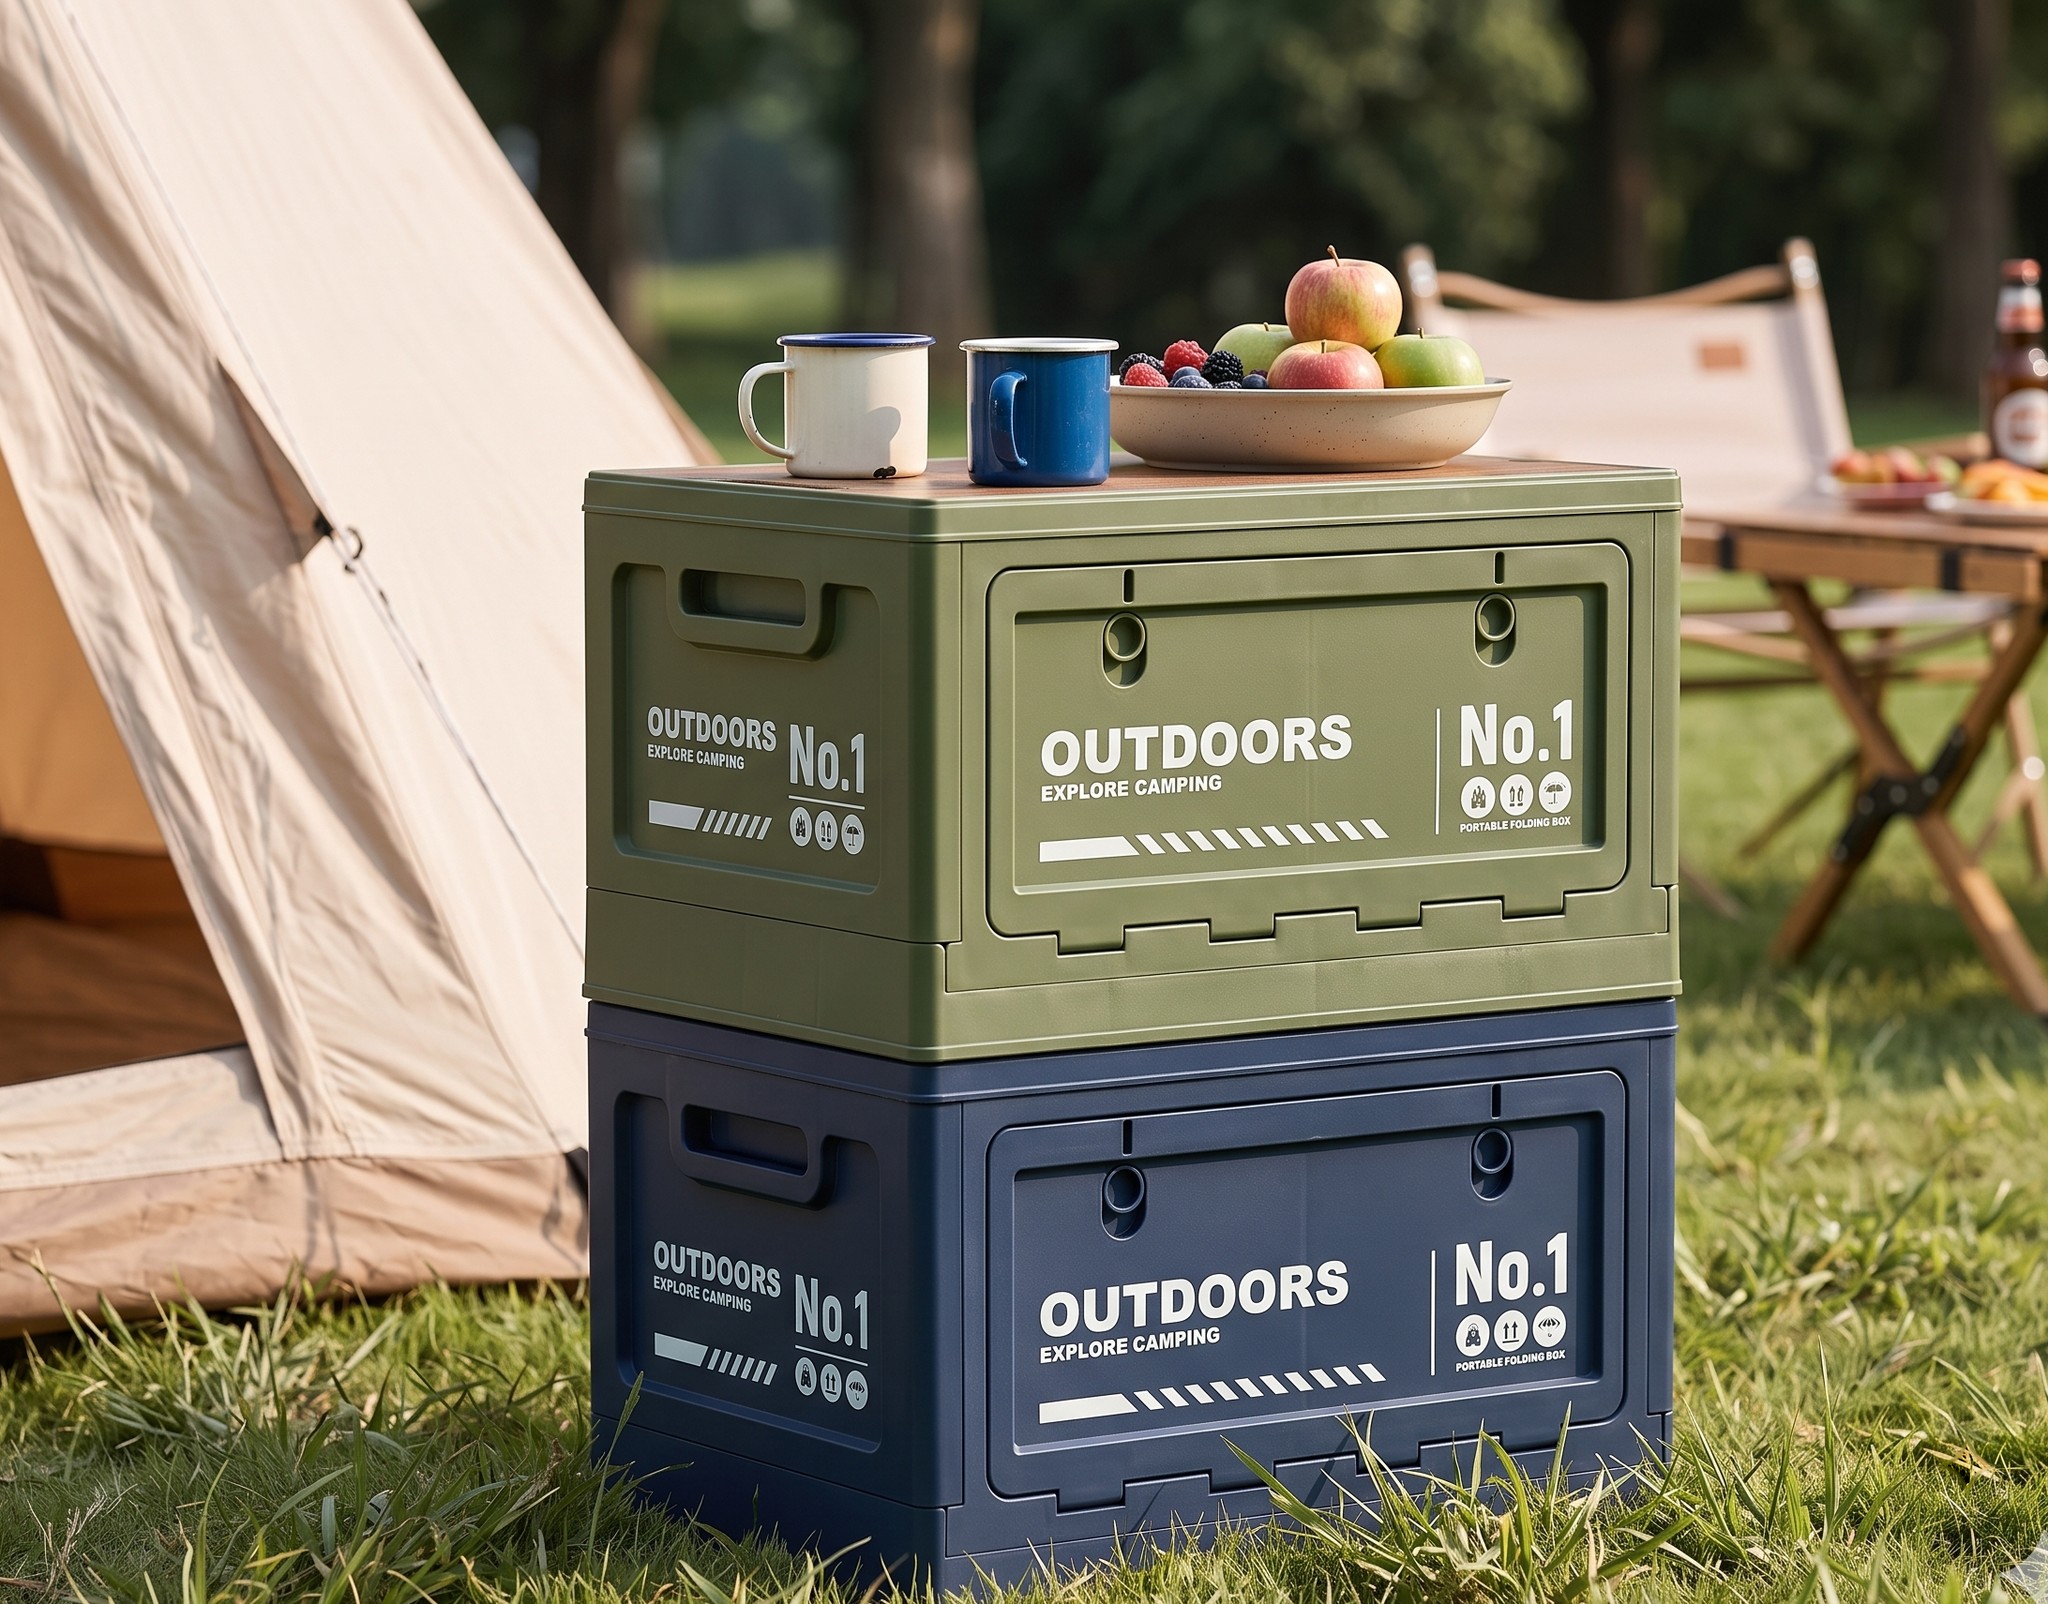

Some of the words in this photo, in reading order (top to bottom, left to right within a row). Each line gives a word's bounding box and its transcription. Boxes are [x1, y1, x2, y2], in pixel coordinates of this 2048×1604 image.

[646, 705, 778, 753] OUTDOORS
[1041, 714, 1352, 777] OUTDOORS
[1460, 699, 1573, 767] No.1
[647, 743, 694, 764] EXPLORE
[696, 750, 745, 770] CAMPING
[789, 723, 865, 794] No.1
[1041, 780, 1129, 802] EXPLORE
[1134, 774, 1222, 796] CAMPING
[1459, 820, 1509, 833] PORTABLE
[1510, 817, 1550, 830] FOLDING
[1551, 816, 1571, 827] BOX
[653, 1240, 781, 1298] OUTDOORS
[653, 1275, 700, 1301] EXPLORE
[702, 1288, 752, 1313] CAMPING
[1455, 1232, 1568, 1306] No.1
[795, 1273, 868, 1350] No.1
[1040, 1260, 1349, 1338] OUTDOORS
[1040, 1337, 1128, 1364] EXPLORE
[1132, 1326, 1220, 1353] CAMPING
[1455, 1357, 1504, 1372] PORTABLE
[1504, 1352, 1545, 1366] FOLDING
[1546, 1349, 1566, 1361] BOX
